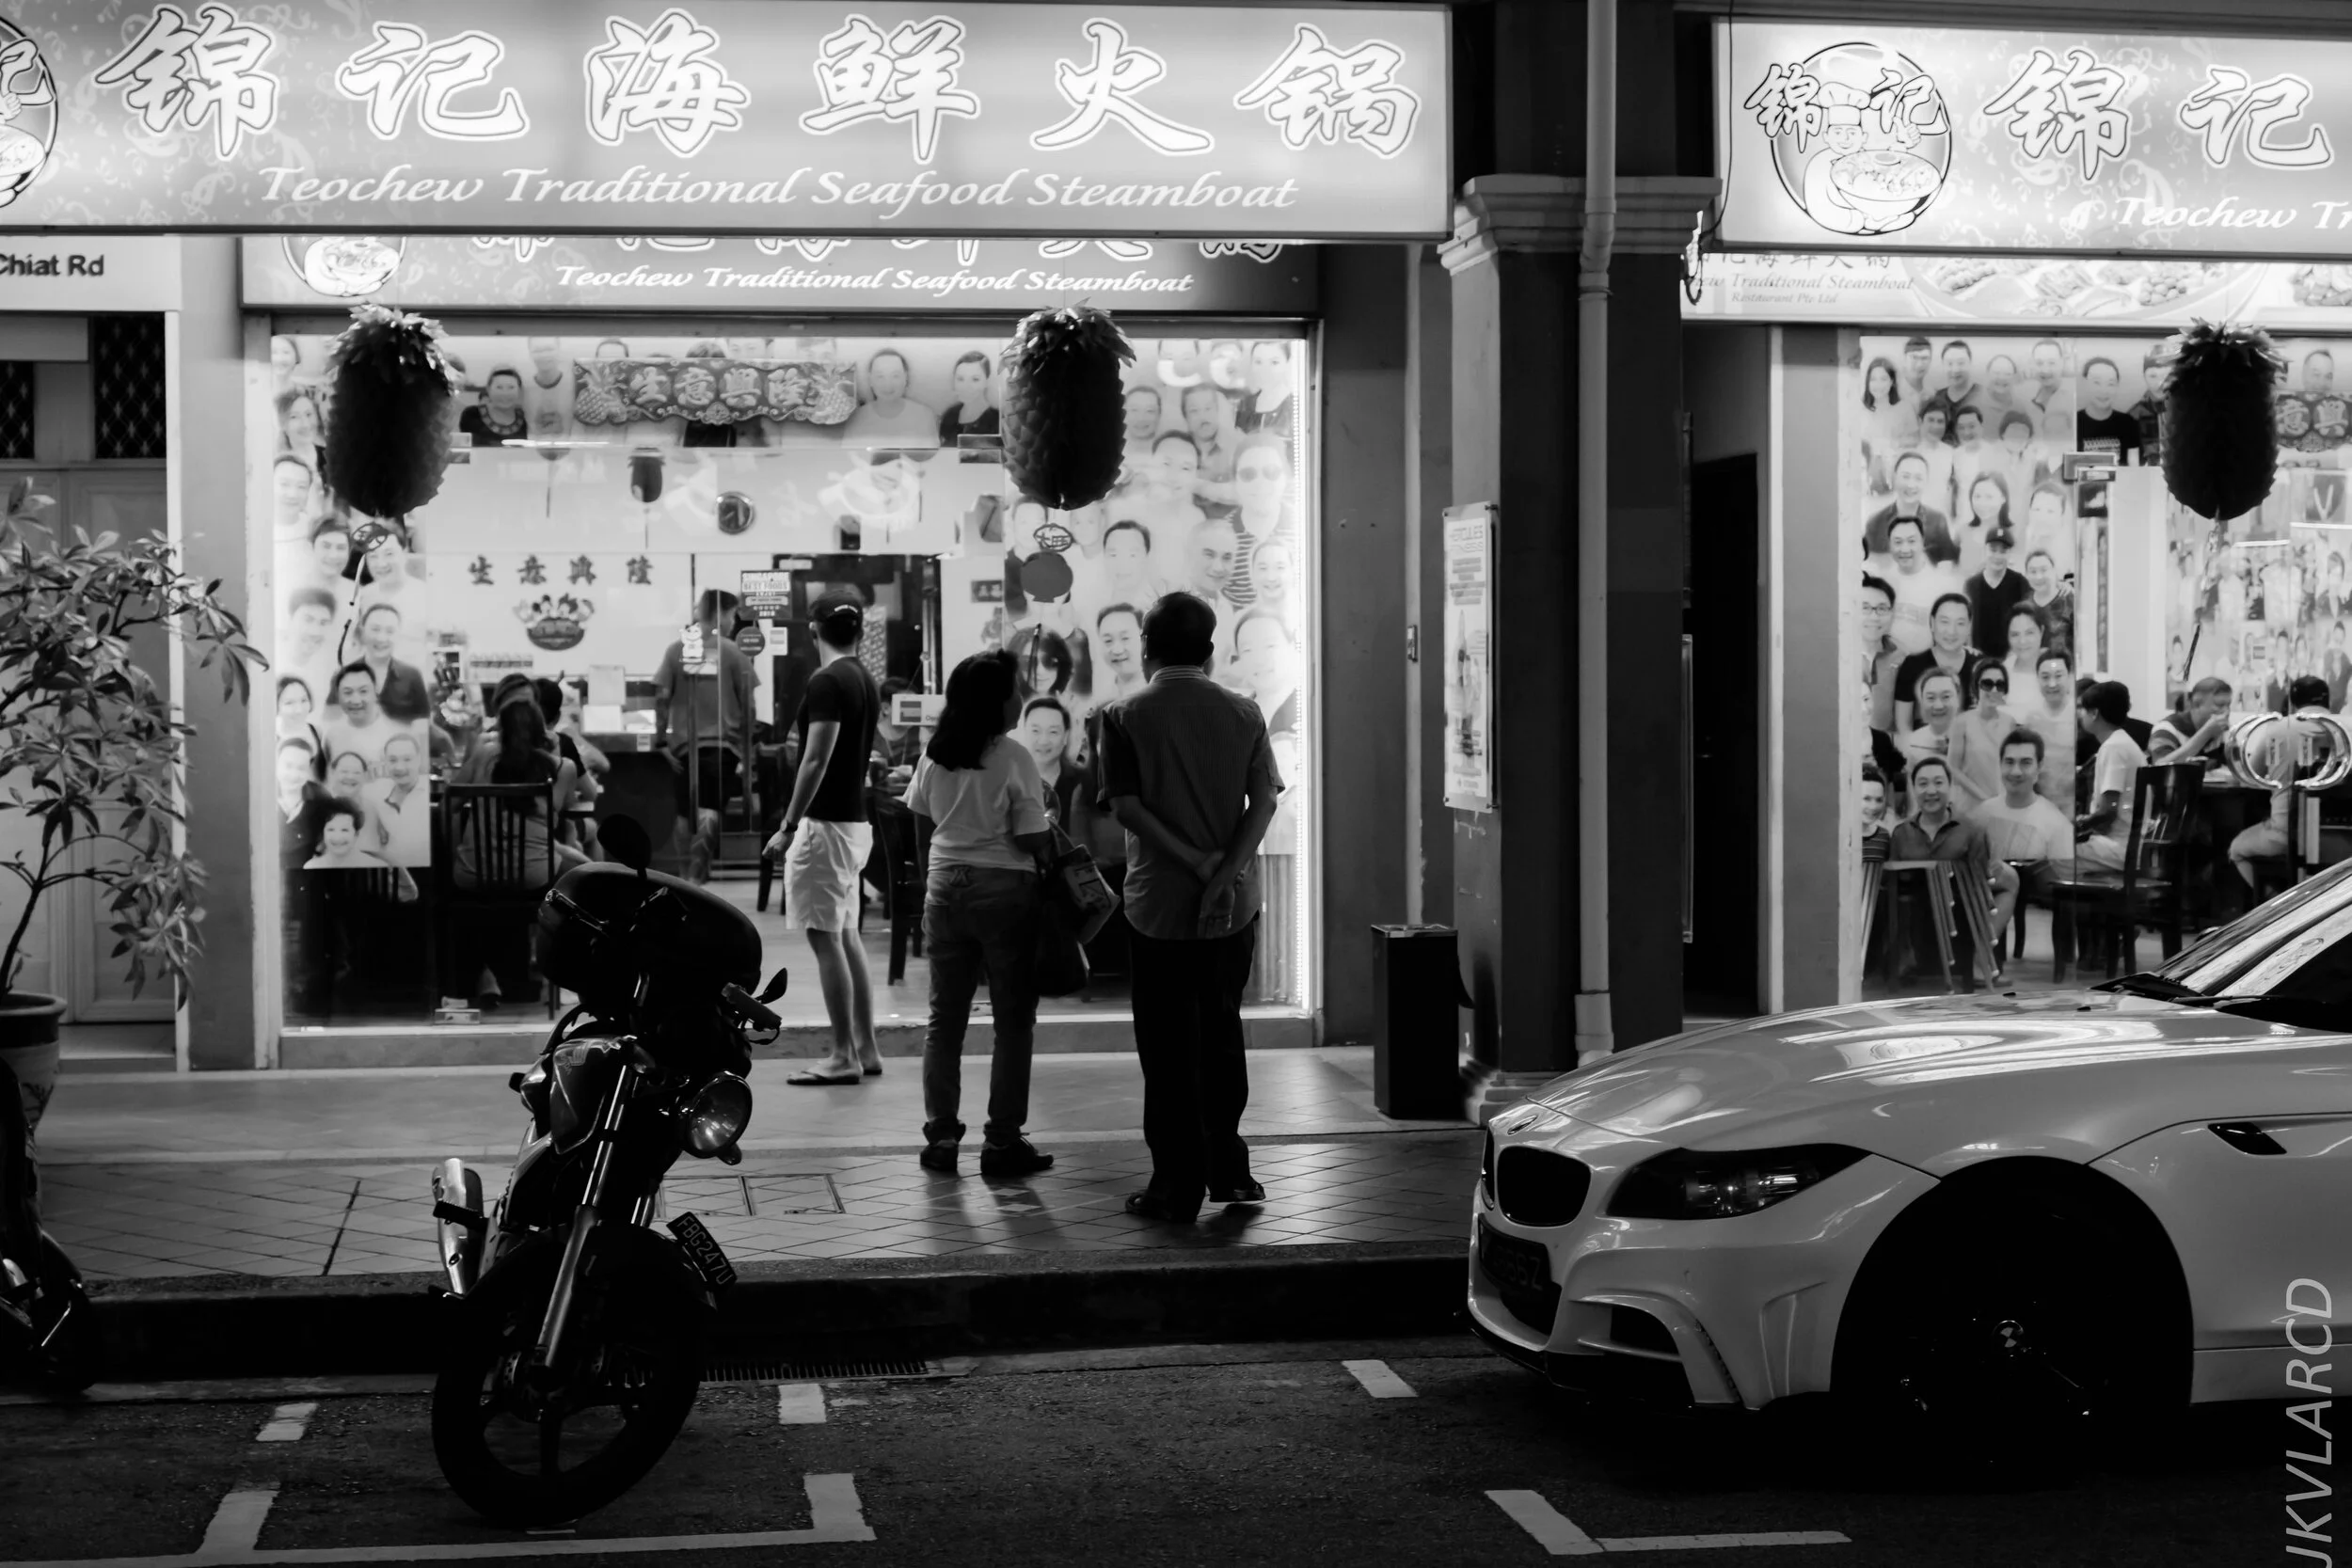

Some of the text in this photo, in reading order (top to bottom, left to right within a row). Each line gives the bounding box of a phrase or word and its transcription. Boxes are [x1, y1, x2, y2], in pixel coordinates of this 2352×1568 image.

[1743, 62, 1949, 153] 锦记
[1982, 46, 2336, 182] 锦记
[259, 165, 1299, 219] Teochew Traditional Seafood Steamboat
[2115, 196, 2297, 229] Teochew
[68, 255, 104, 276] Rd
[556, 264, 1195, 297] Teochew Traditional Seafood Steamboat
[1731, 273, 1822, 290] Traditional
[1827, 275, 1915, 291] Steamboat
[677, 1216, 735, 1285] FBG247U
